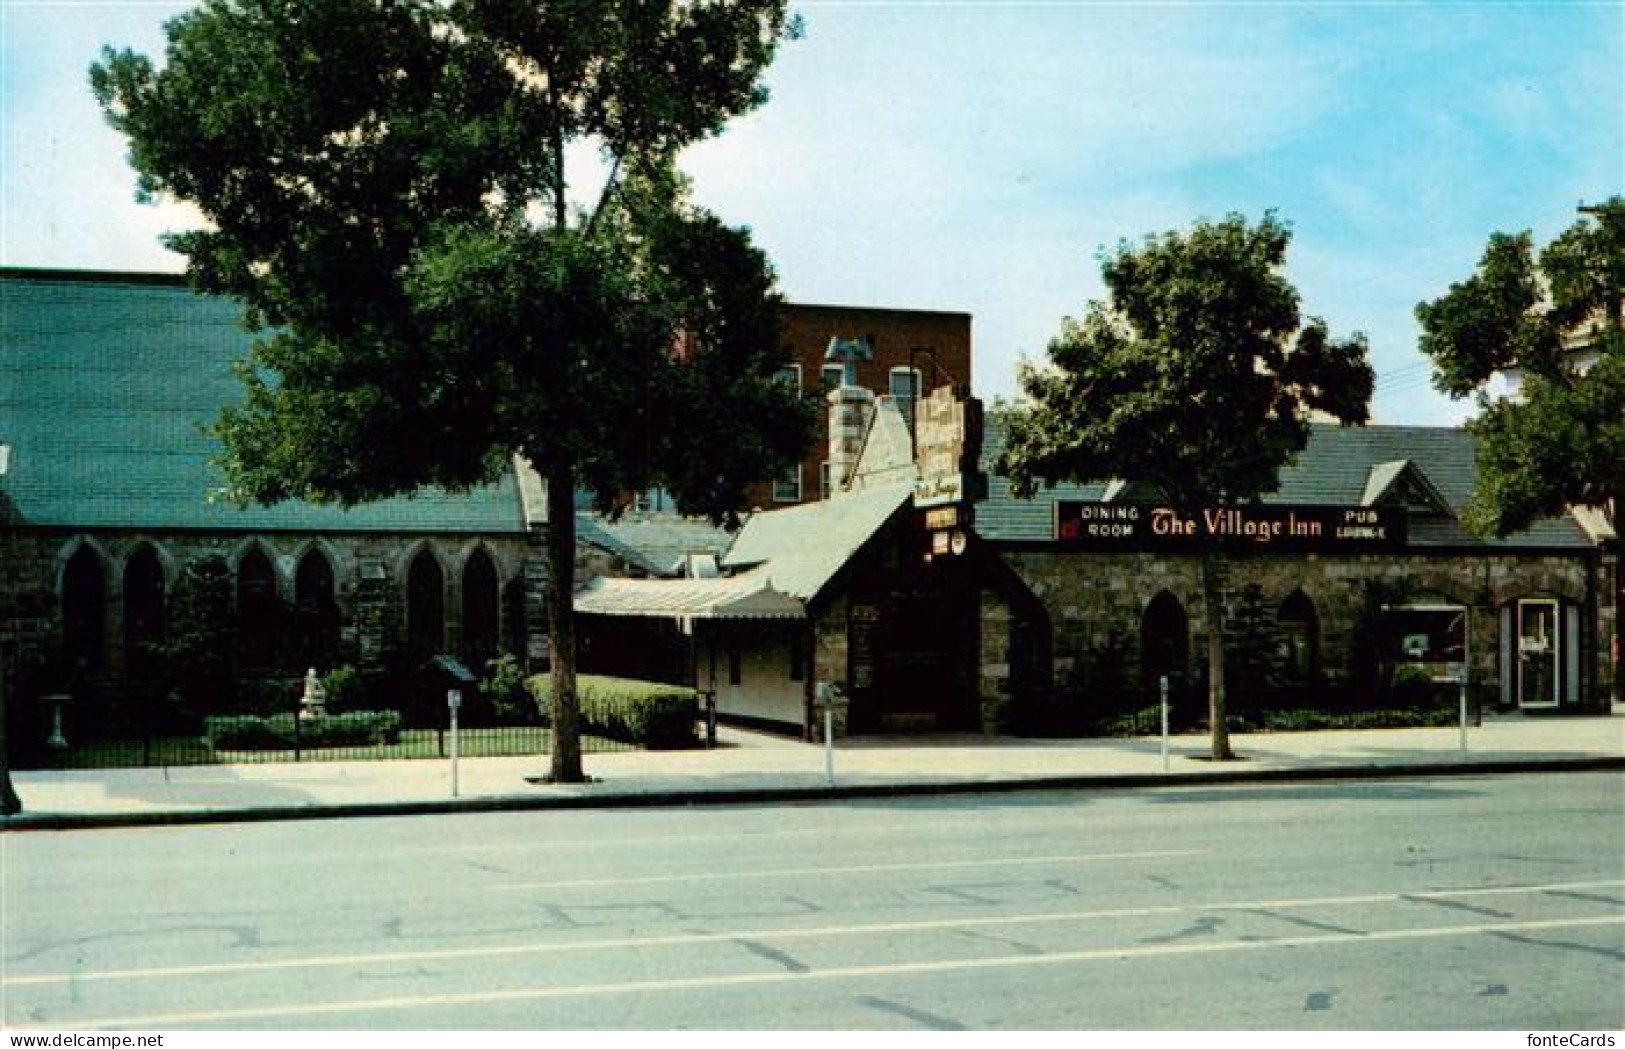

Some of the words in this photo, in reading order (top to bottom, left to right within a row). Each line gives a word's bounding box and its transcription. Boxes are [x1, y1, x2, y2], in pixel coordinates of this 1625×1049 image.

[1081, 506, 1138, 519] DINING
[1345, 510, 1378, 523] PUB
[1088, 524, 1133, 537] ROOM
[1151, 508, 1197, 535] The
[1204, 508, 1283, 542] Village
[1289, 511, 1323, 536] Inn
